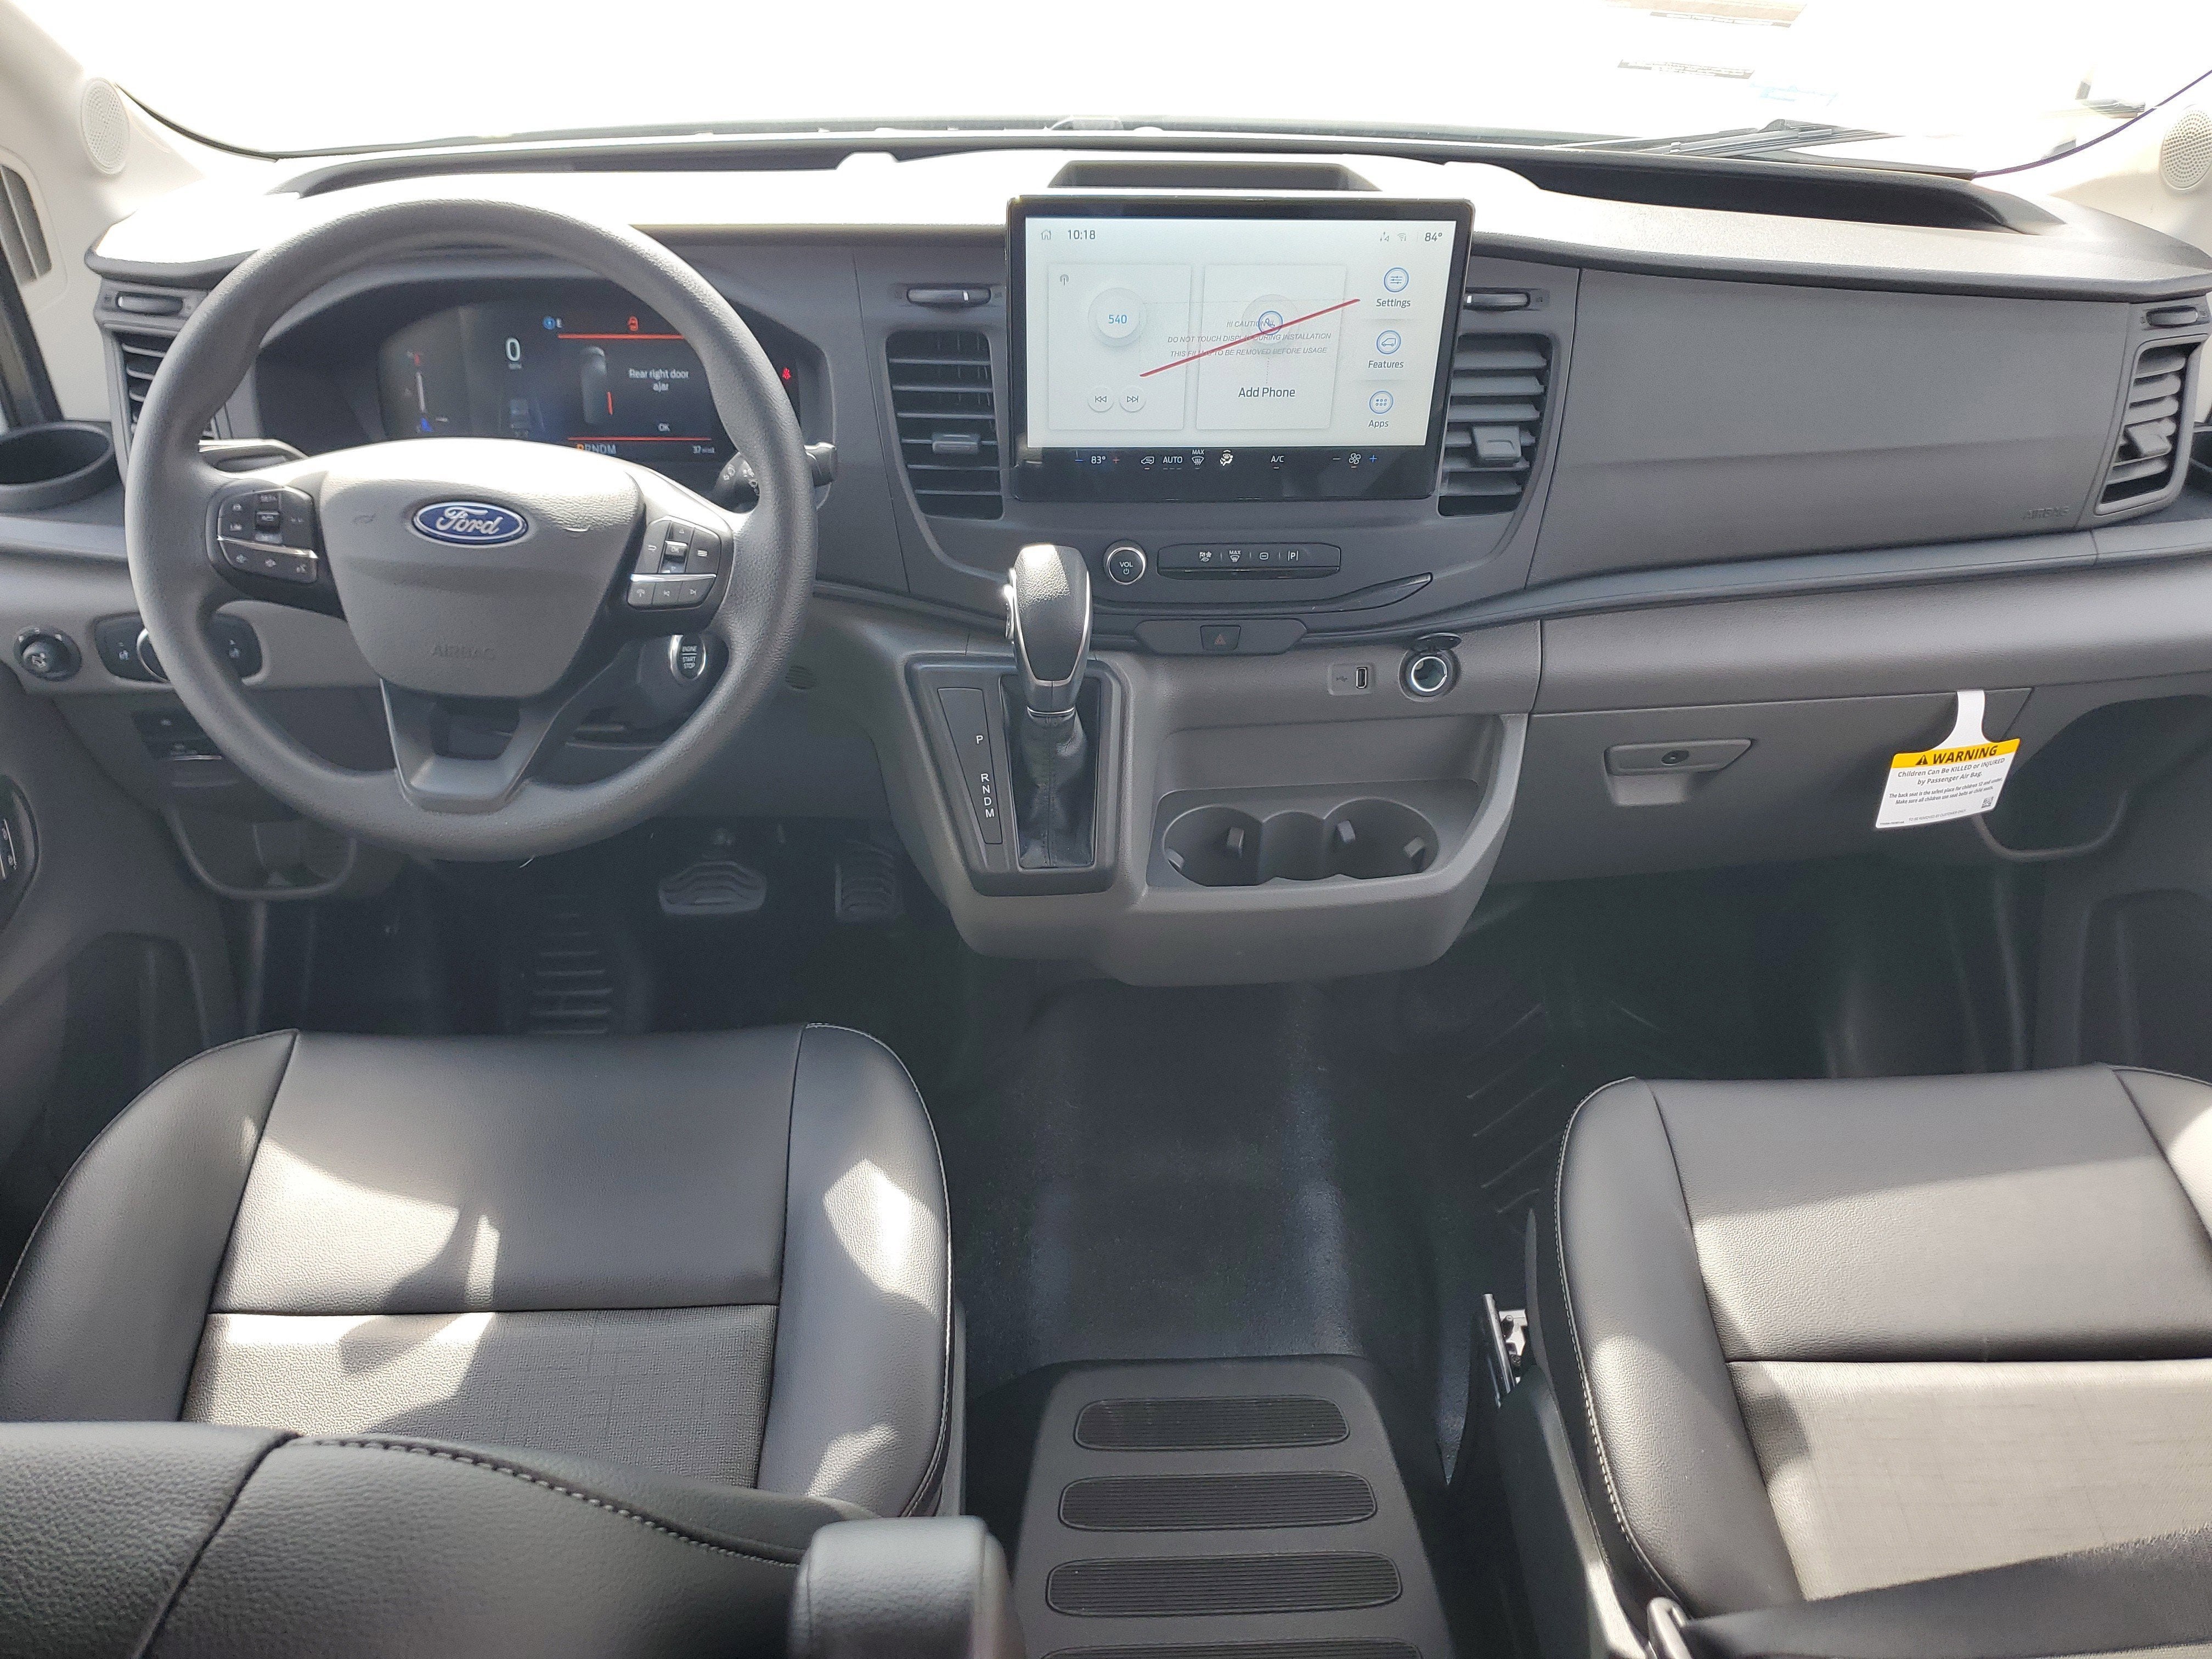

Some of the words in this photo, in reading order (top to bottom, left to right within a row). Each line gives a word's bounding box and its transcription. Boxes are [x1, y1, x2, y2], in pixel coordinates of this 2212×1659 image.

[1068, 230, 1096, 240] 10:18
[1425, 232, 1442, 241] 84°
[1376, 298, 1411, 308] Settings
[1108, 314, 1127, 324] 540
[505, 337, 521, 362] 0
[1368, 360, 1404, 369] Features
[628, 368, 648, 379] Rear
[649, 368, 669, 380] right
[669, 369, 689, 379] door
[1238, 387, 1260, 397] Add
[1262, 387, 1295, 397] Phone
[658, 423, 671, 432] OK
[1368, 420, 1389, 429] Apps
[436, 506, 504, 535] Ford
[976, 735, 983, 744] P
[1933, 745, 1998, 764] WARNING
[1981, 758, 2005, 767] INJURED
[981, 774, 990, 782] R
[1927, 775, 1959, 784] Passenger
[983, 785, 990, 794] N
[984, 797, 992, 806] D
[985, 809, 995, 818] M
